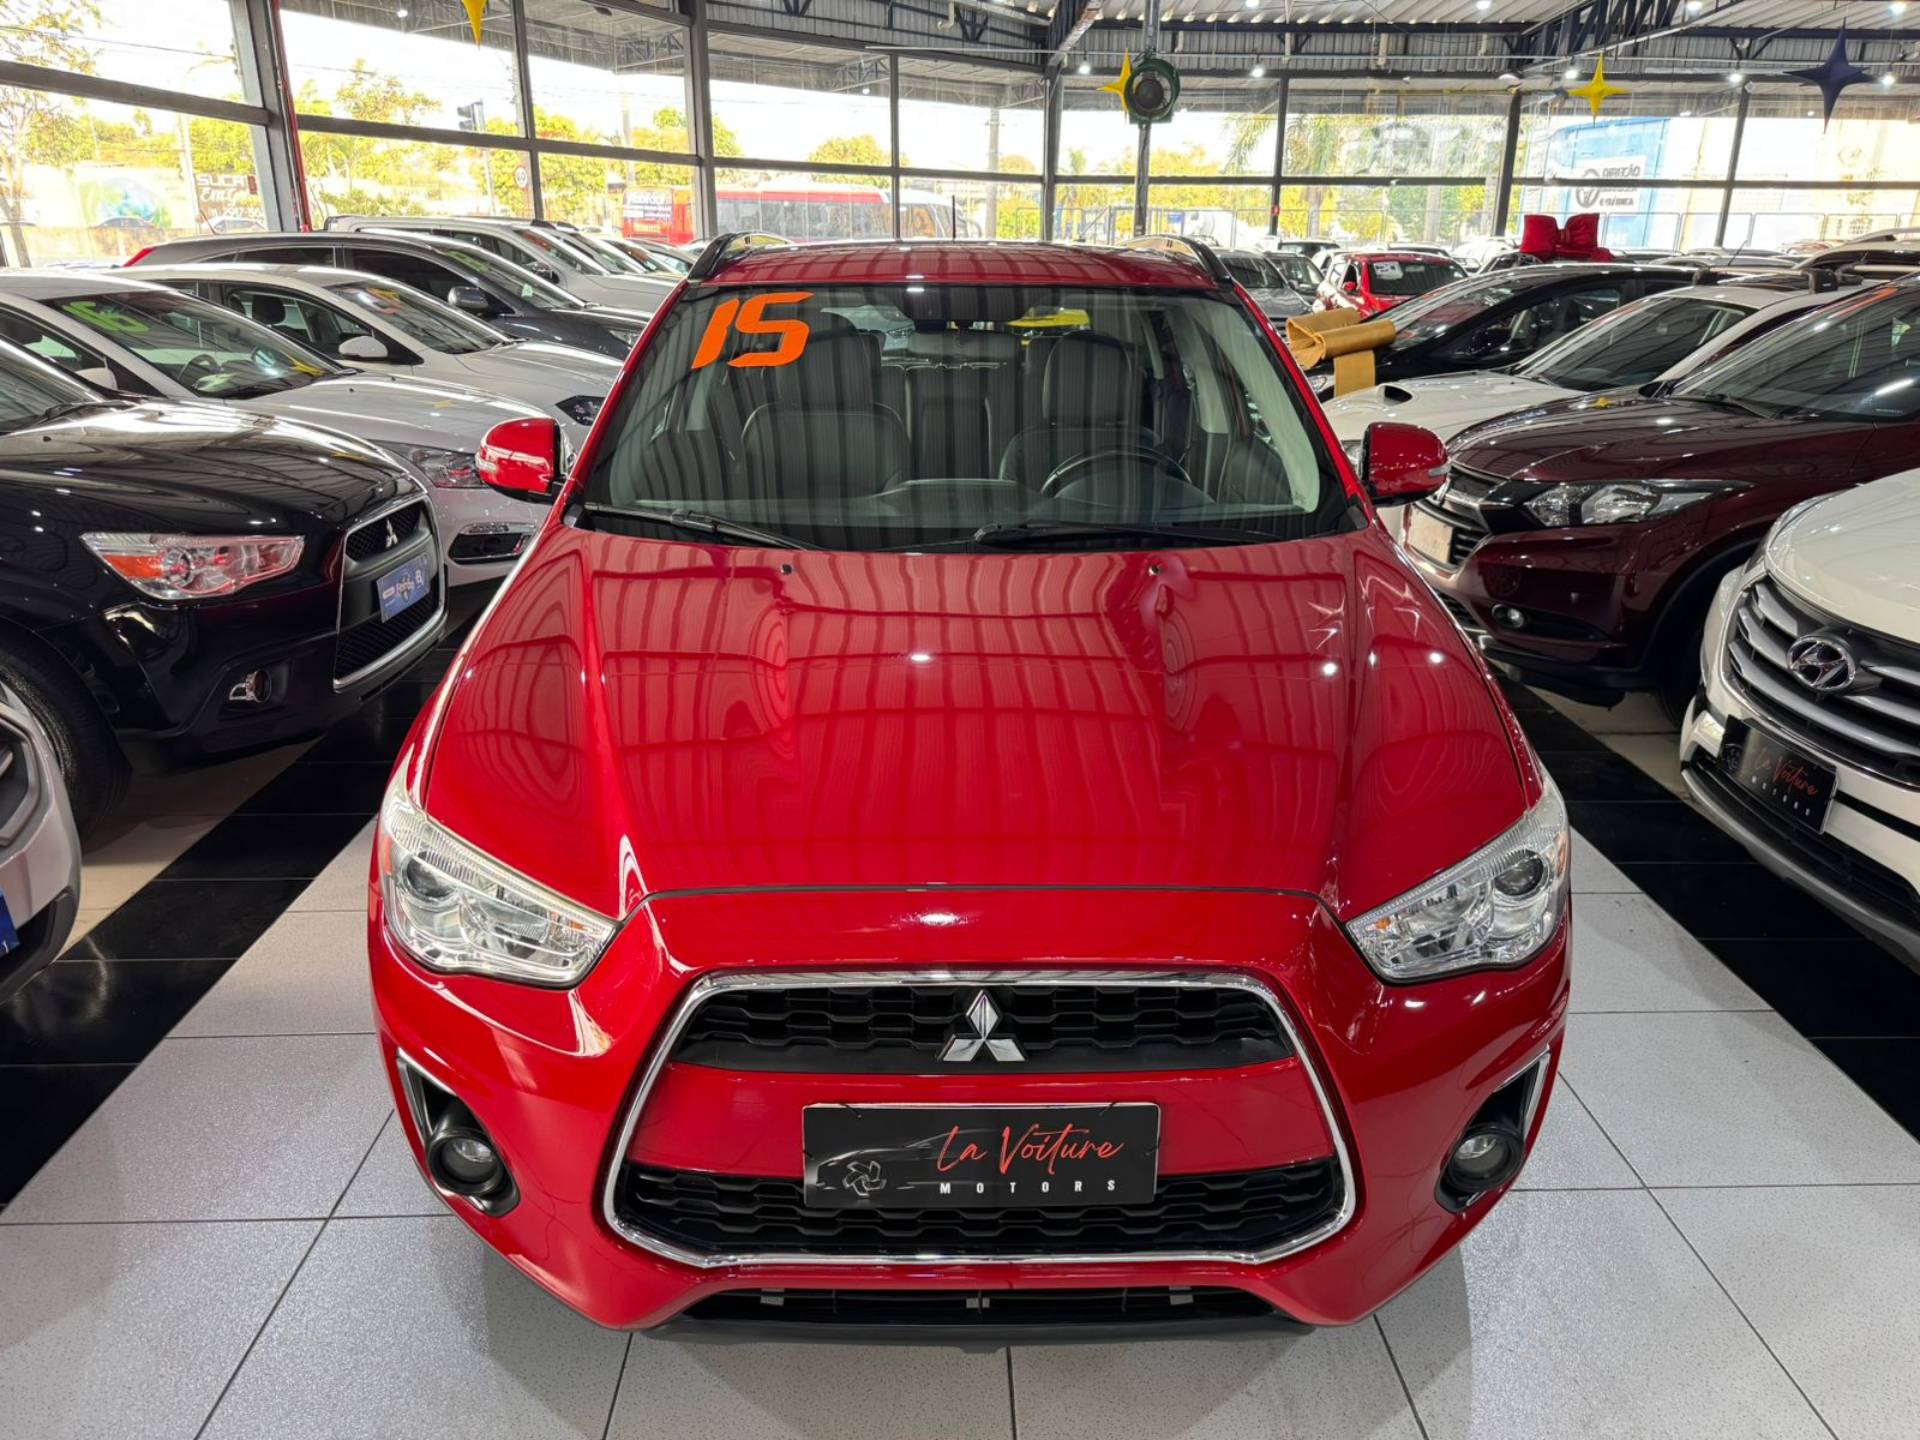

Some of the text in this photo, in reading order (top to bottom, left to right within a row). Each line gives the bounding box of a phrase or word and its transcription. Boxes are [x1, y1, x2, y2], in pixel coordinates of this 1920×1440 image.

[691, 291, 815, 369] 15
[1772, 755, 1818, 797] Voiture
[937, 1123, 1125, 1175] La Voiture
[939, 1180, 1116, 1195] MOTORS
